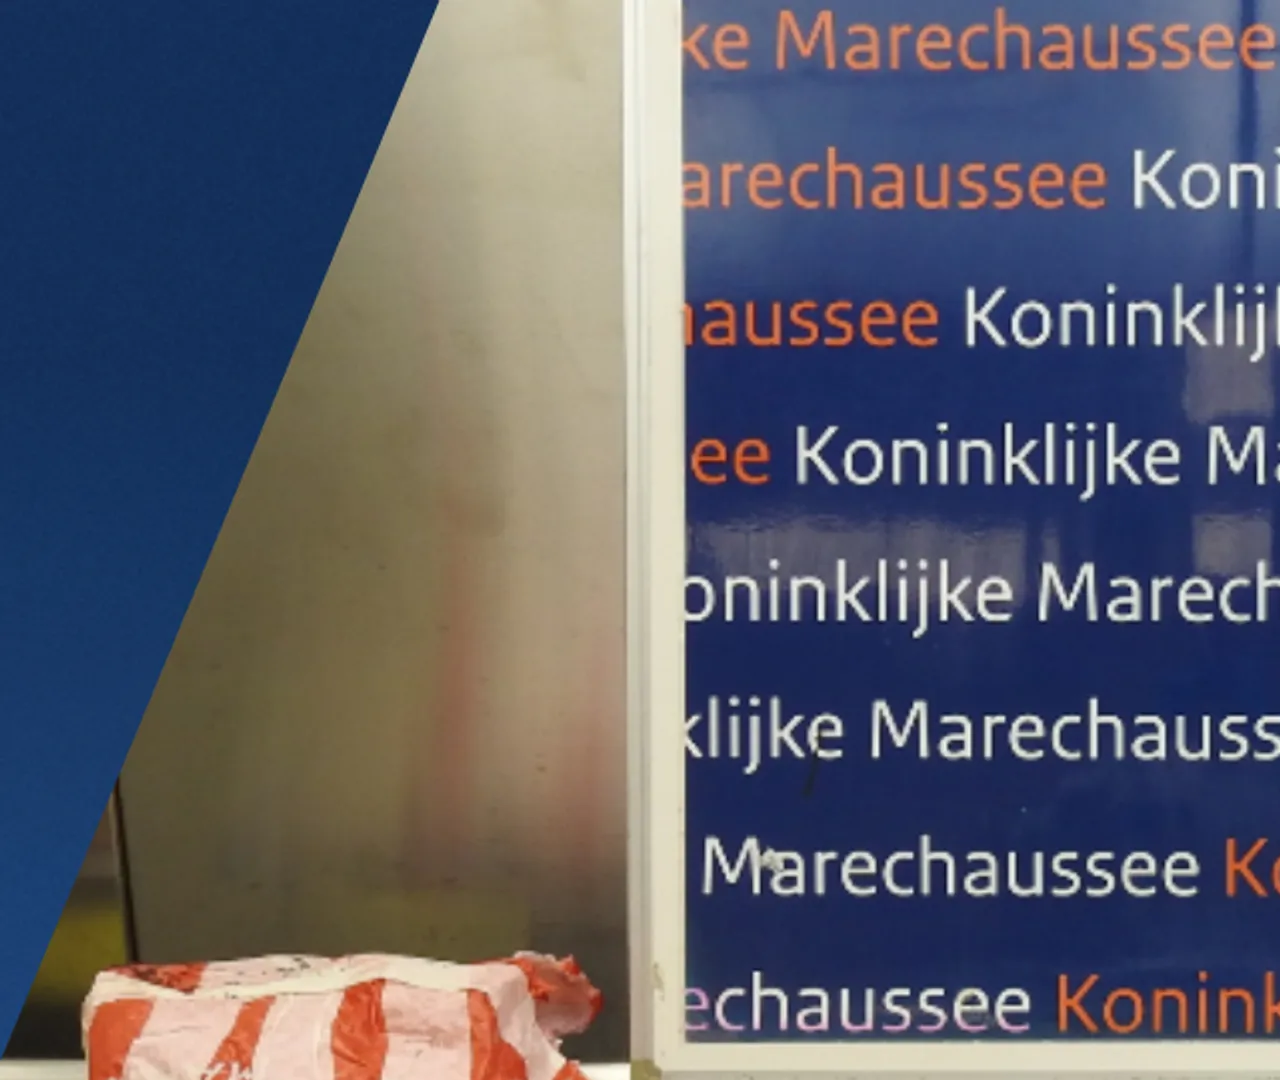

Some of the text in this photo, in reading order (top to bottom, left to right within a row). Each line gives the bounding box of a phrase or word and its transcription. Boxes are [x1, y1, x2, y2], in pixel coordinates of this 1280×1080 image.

[777, 9, 1276, 71] Marechaussee
[682, 147, 1107, 209] arechaussee
[690, 438, 770, 484] ee
[797, 423, 1180, 499] Koninklijke
[684, 559, 1013, 637] oninklijke
[704, 835, 1199, 897] Marechaussee
[684, 971, 1031, 1032] echaussee
